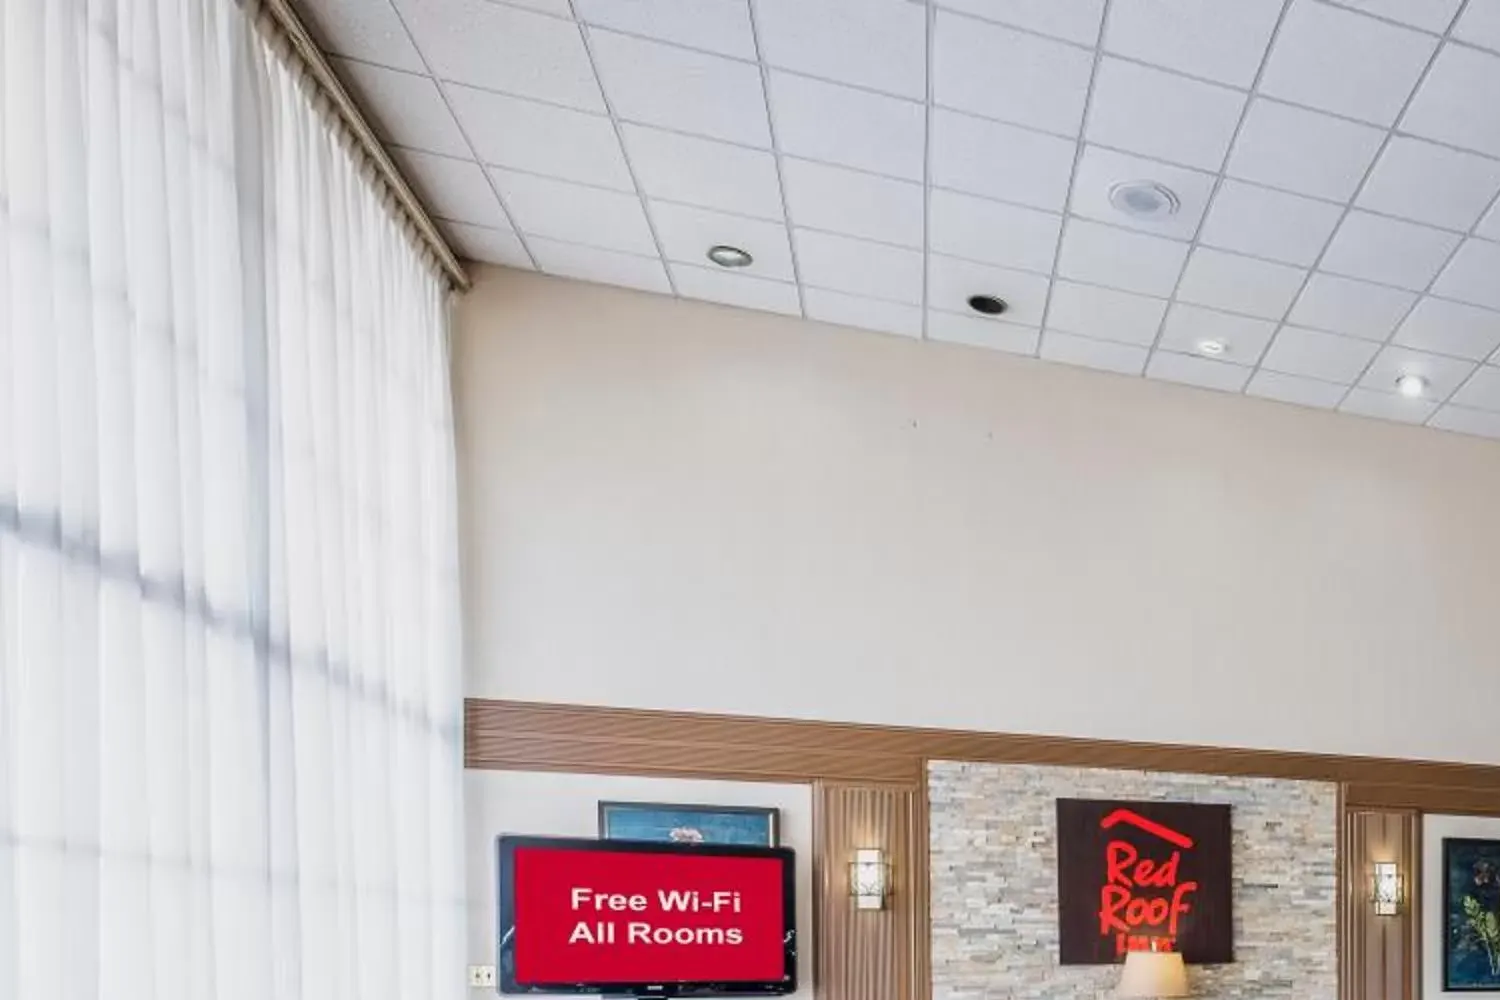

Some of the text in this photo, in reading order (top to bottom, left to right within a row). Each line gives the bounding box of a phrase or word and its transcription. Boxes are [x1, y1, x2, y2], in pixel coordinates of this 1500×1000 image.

[1106, 840, 1180, 887] Red
[570, 887, 742, 913] Free Wi-Fi
[1100, 882, 1197, 935] Roof
[568, 921, 744, 945] All Rooms
